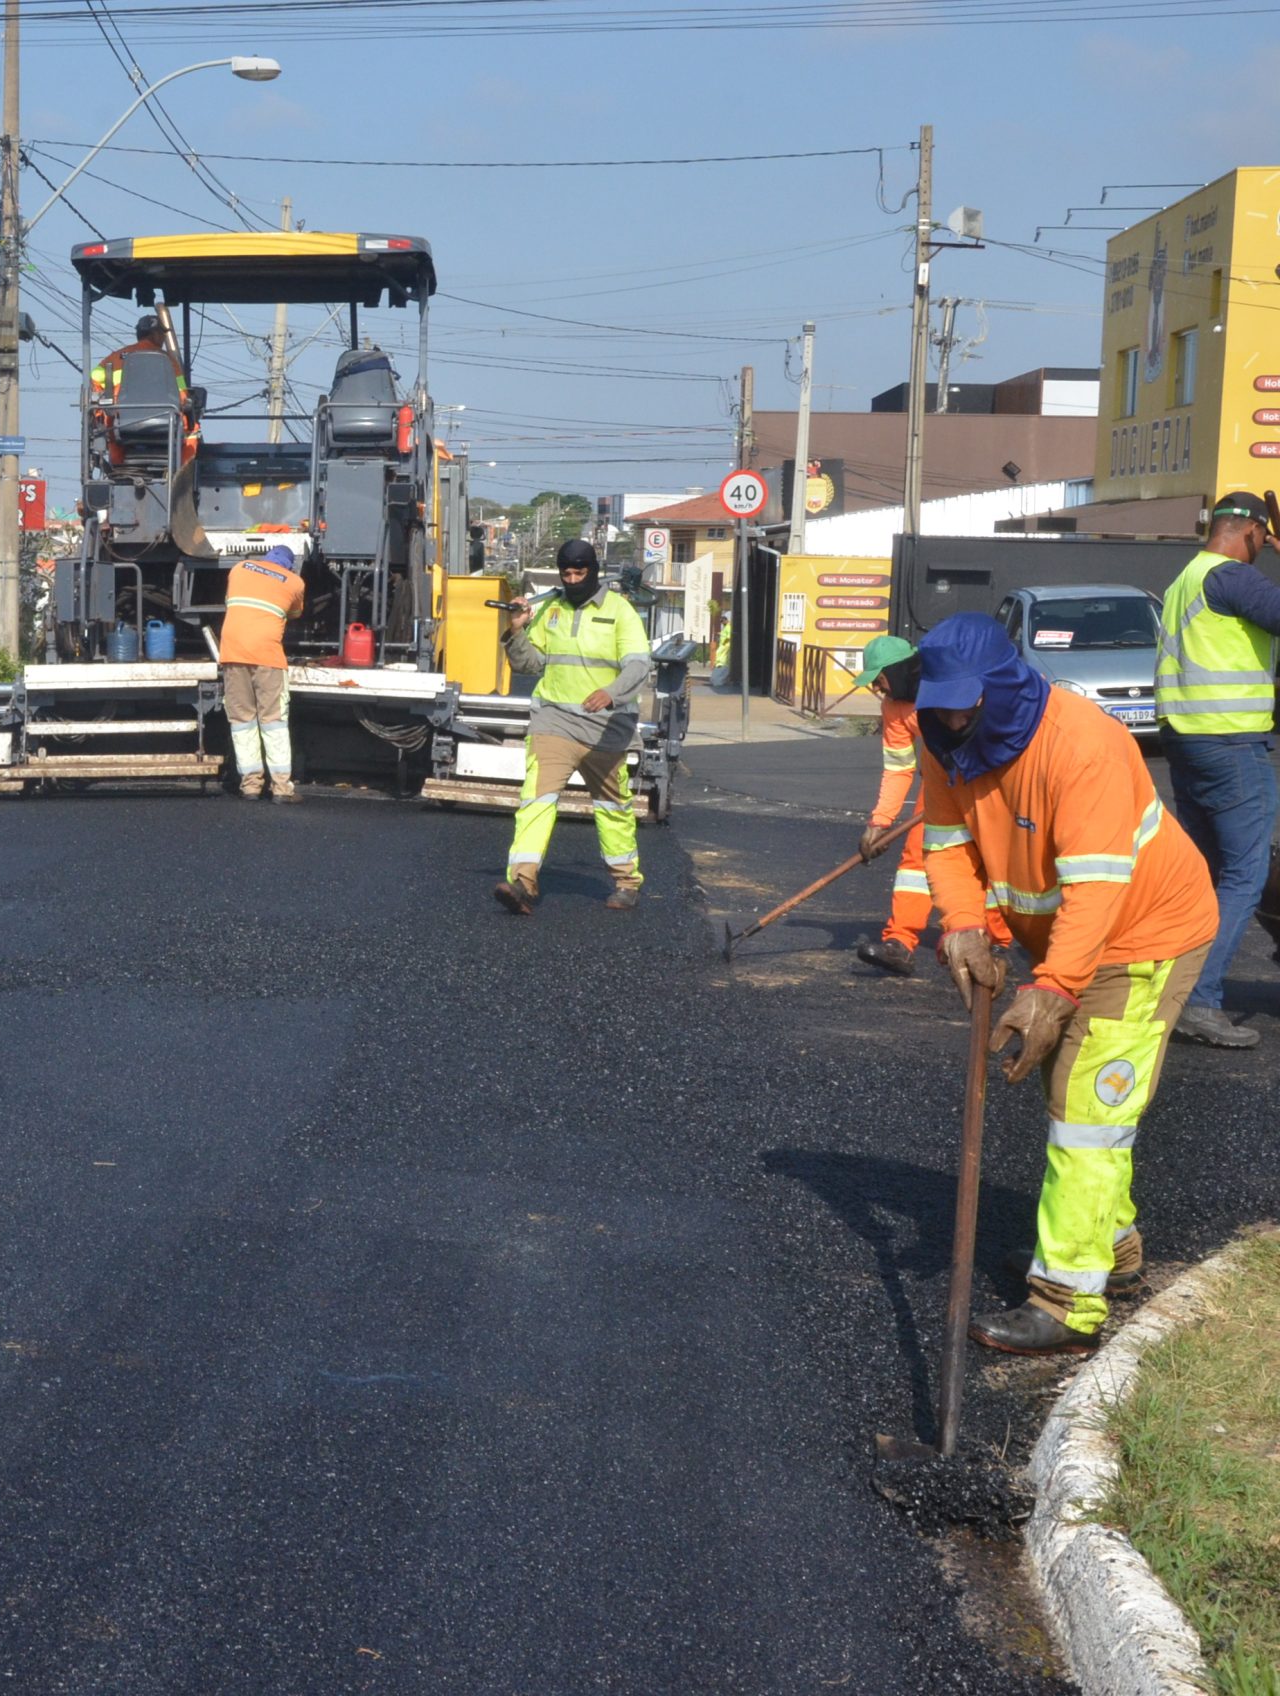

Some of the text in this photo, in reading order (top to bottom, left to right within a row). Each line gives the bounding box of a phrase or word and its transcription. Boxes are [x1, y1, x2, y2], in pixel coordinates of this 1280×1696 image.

[1110, 415, 1192, 480] DOGUERIA
[1260, 445, 1277, 455] Hot
[730, 484, 757, 501] 40
[653, 534, 661, 545] E
[836, 620, 877, 629] Americano
